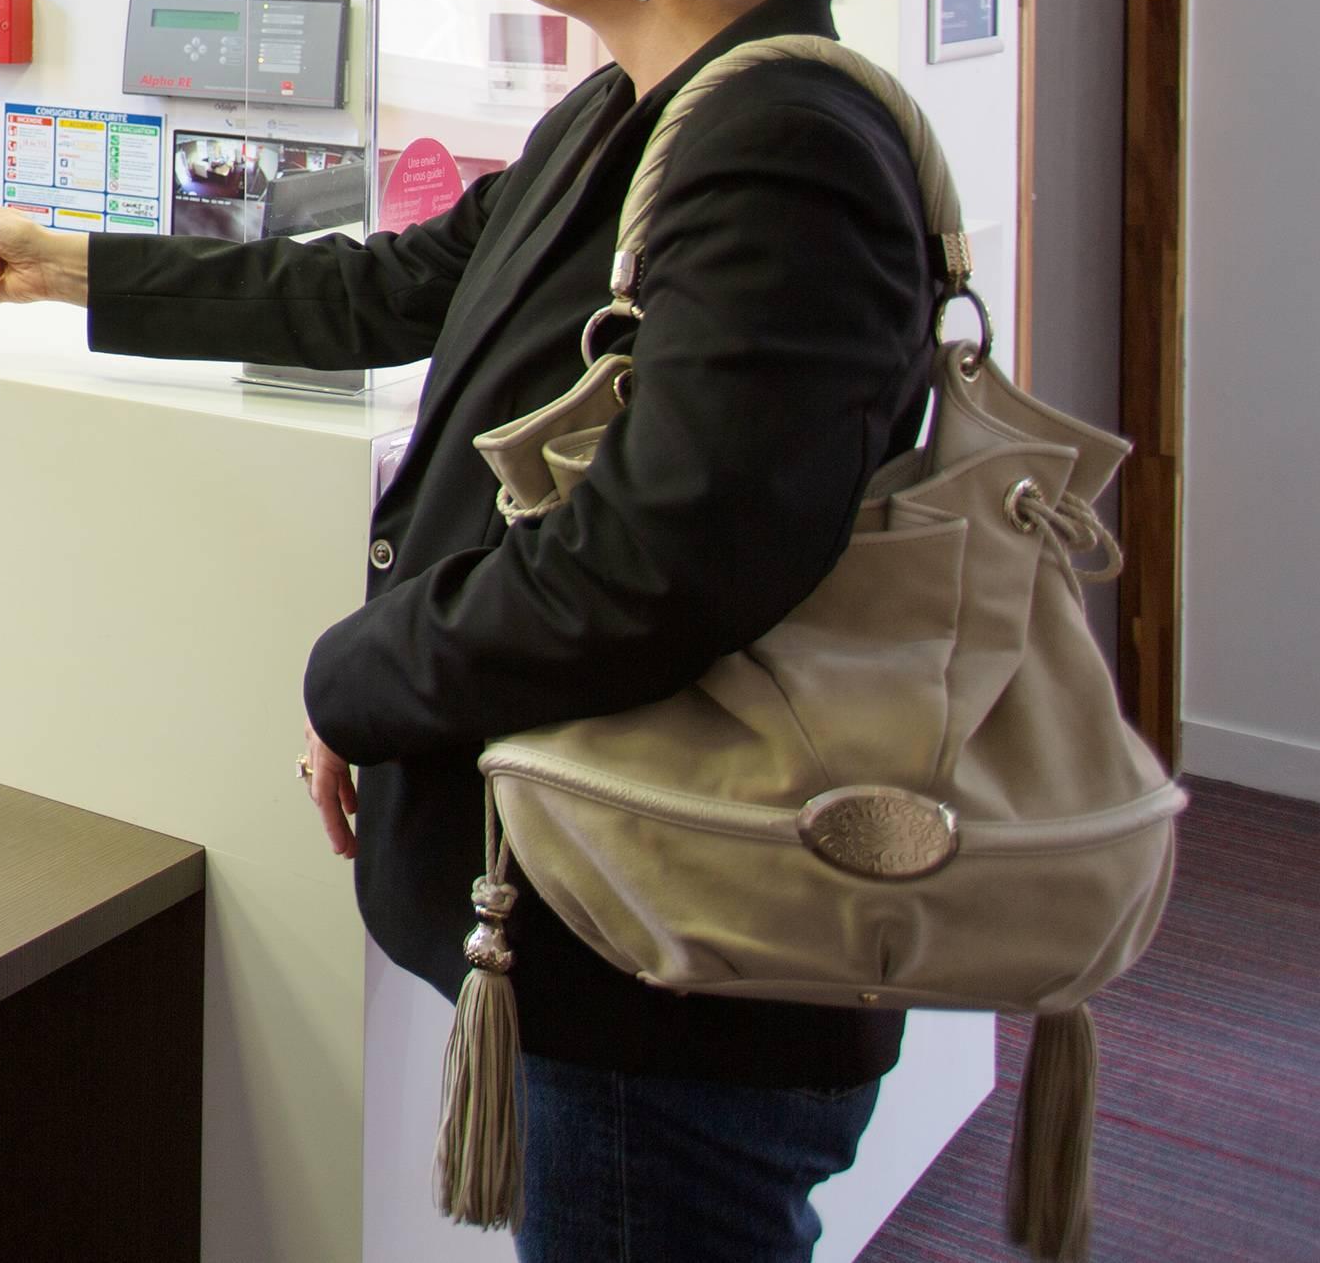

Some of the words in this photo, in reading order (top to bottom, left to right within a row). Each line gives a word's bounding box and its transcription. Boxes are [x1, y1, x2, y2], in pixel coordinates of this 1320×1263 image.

[35, 106, 78, 119] CONSIGNES
[78, 110, 90, 119] DE
[408, 158, 420, 169] Une
[402, 172, 411, 183] On
[412, 170, 426, 182] vous
